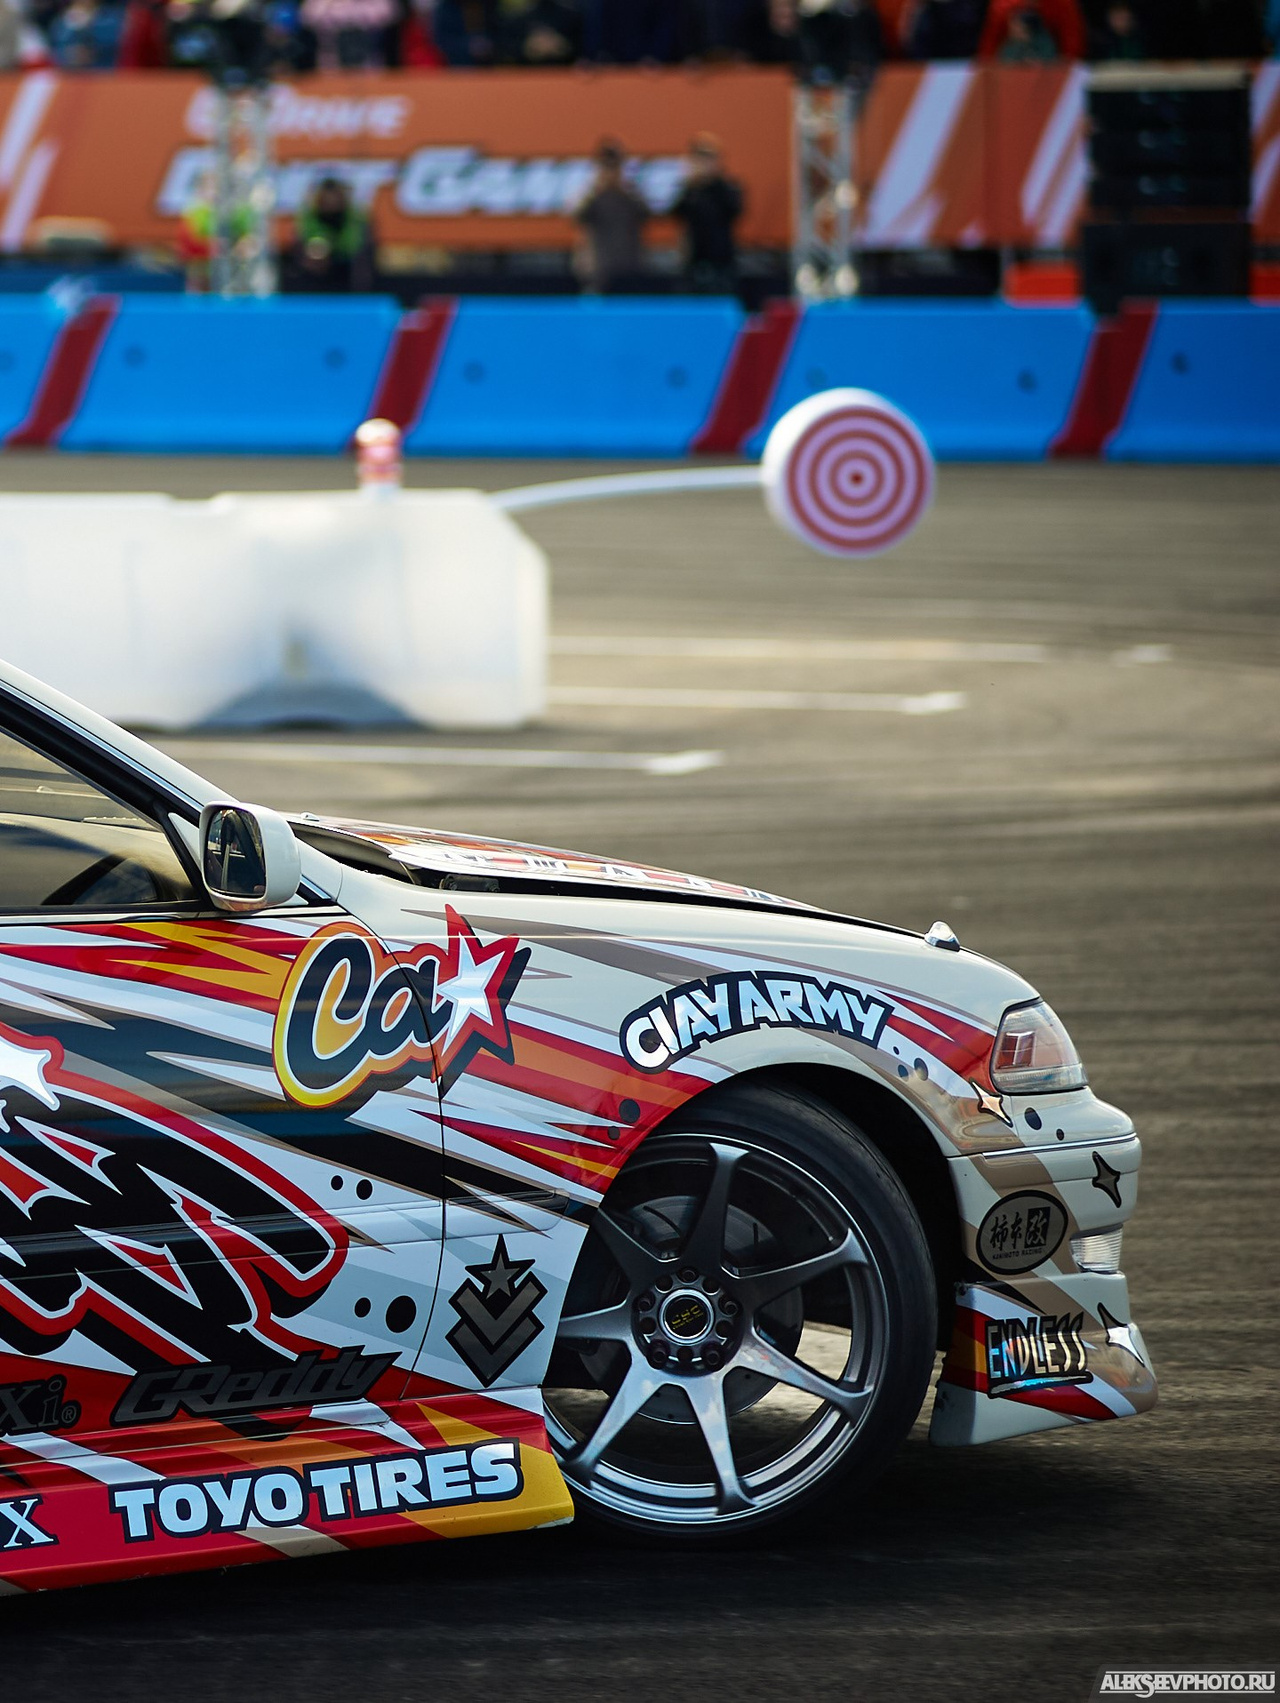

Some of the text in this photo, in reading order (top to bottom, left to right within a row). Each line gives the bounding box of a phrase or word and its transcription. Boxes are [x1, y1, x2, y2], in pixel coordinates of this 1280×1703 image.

[738, 979, 885, 1041] ARMY
[987, 1316, 1086, 1379] ENDLESS
[116, 1443, 520, 1538] TOYO TIRES
